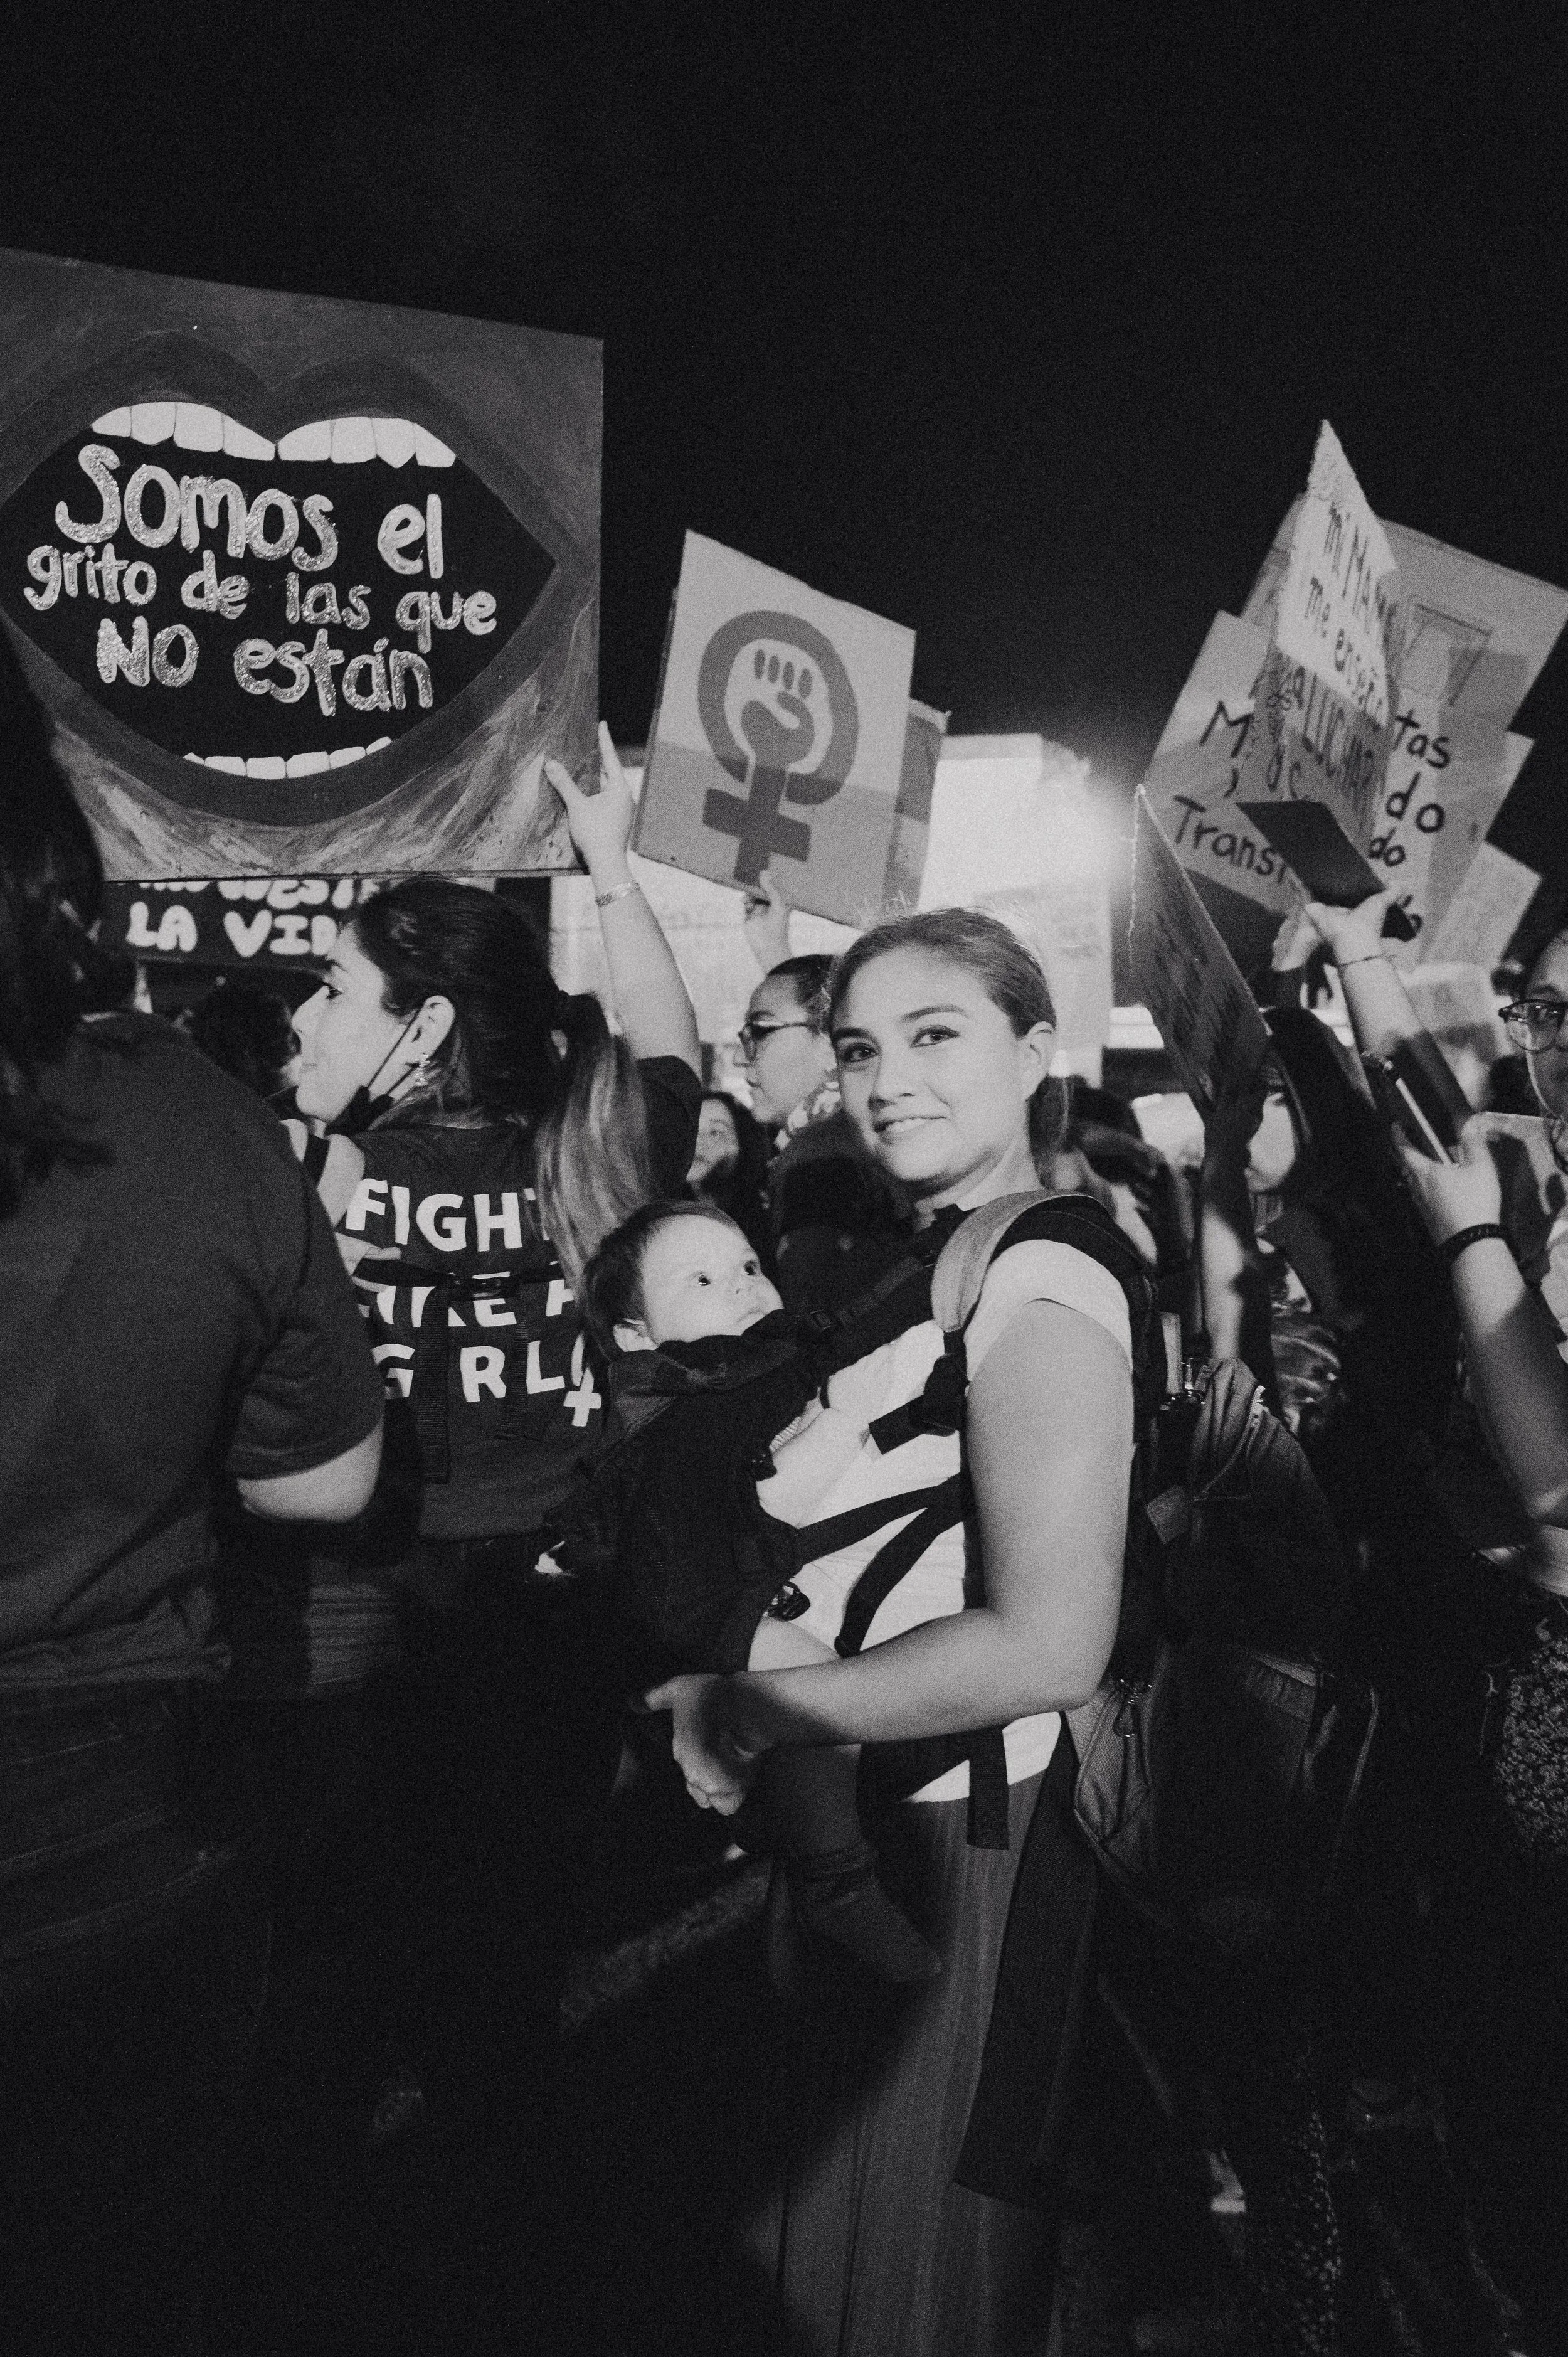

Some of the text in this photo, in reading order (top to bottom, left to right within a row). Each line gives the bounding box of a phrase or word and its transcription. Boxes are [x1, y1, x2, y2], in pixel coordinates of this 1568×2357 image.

[377, 494, 444, 579] el
[24, 544, 497, 653] grito de las que
[96, 615, 434, 716] NO están
[126, 901, 340, 958] LA VID
[346, 1178, 549, 1252] FIGH
[371, 1340, 565, 1403] GRL
